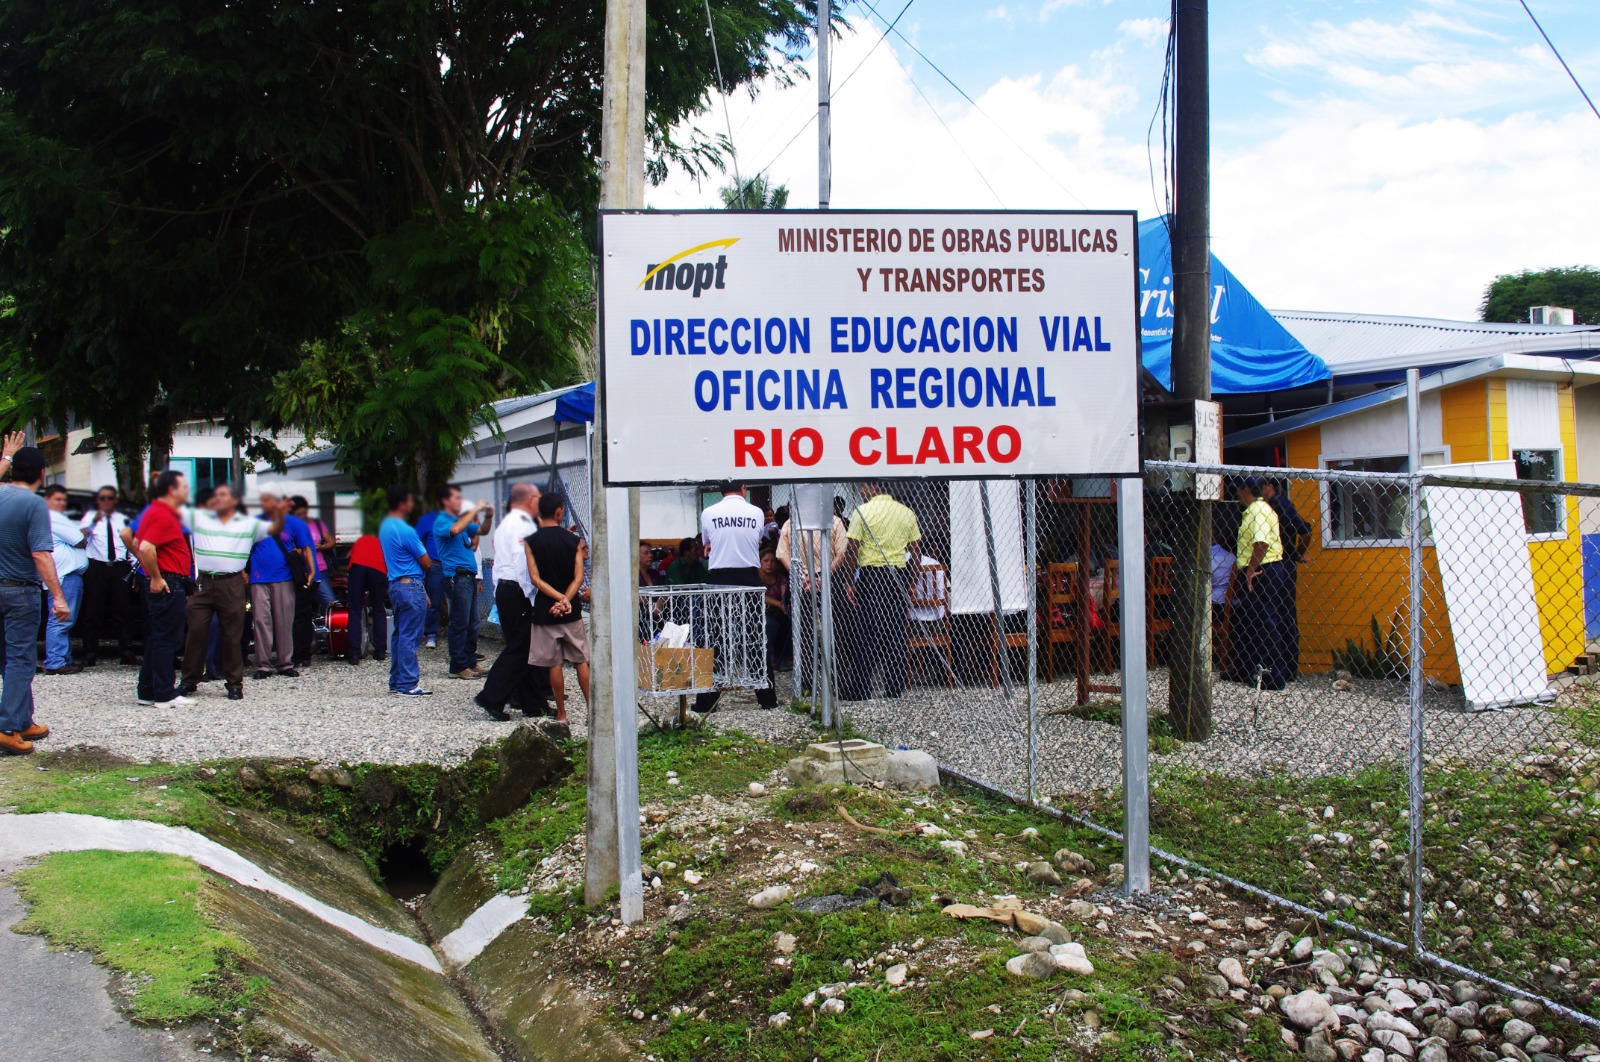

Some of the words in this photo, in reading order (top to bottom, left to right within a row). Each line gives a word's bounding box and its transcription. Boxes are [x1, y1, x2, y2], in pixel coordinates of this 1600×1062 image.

[779, 228, 901, 252] MINISTERIO
[909, 229, 934, 252] DE
[942, 229, 1011, 253] OBRAS
[1018, 229, 1117, 251] PUBLICAS
[645, 256, 727, 297] mopt
[857, 268, 872, 292] Y
[880, 268, 1045, 292] TRANSPORTES
[631, 317, 810, 355] DIRECCION
[831, 316, 1017, 353] EDUCACION
[1039, 316, 1111, 351] VIAL
[695, 369, 848, 412] OFICINA
[871, 367, 1056, 408] REGIONAL
[734, 428, 823, 467] RIO
[849, 425, 1021, 465] CLARO
[712, 517, 756, 529] TRANSITO
